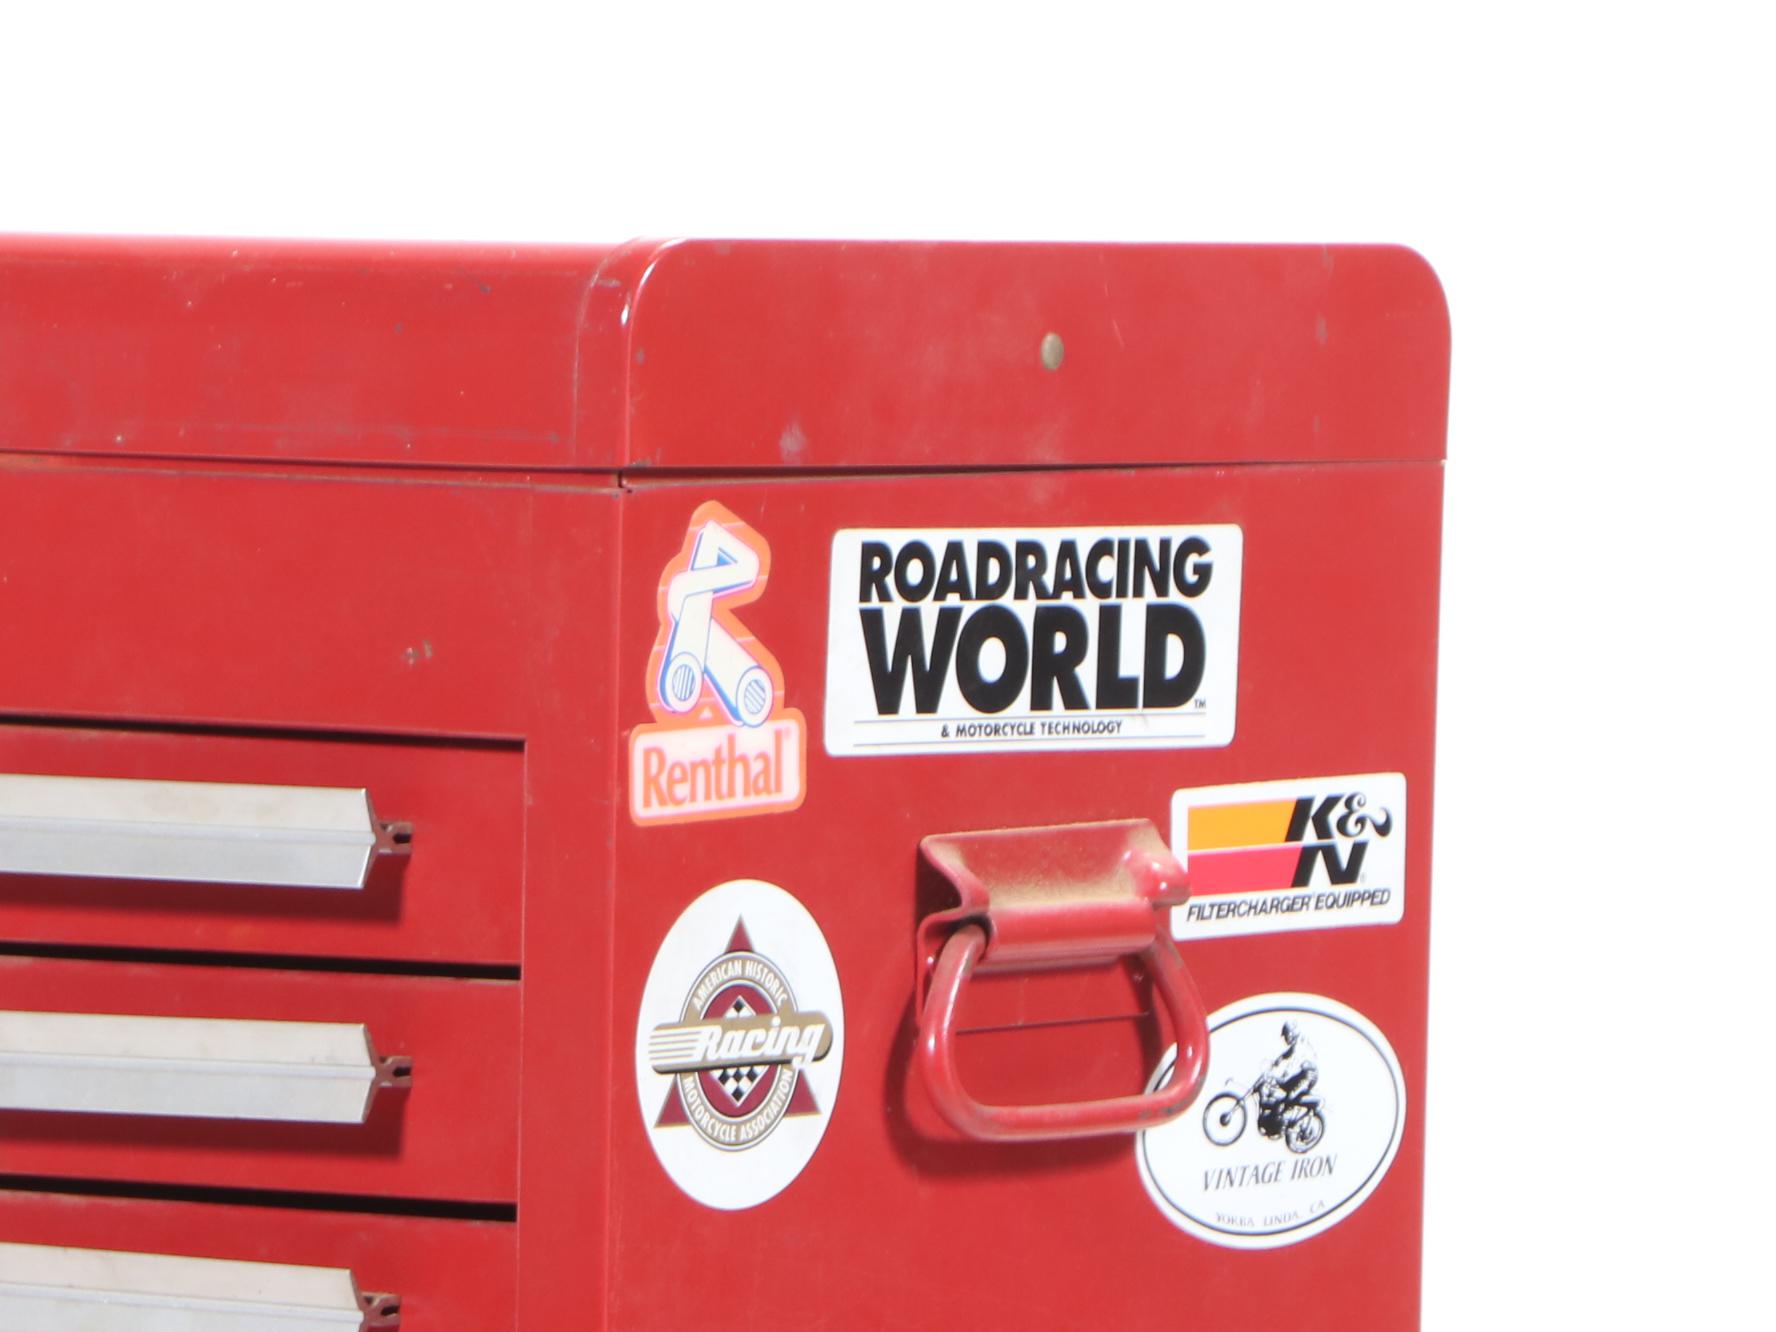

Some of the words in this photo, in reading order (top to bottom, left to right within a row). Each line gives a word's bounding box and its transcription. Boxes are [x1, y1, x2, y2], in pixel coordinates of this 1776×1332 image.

[858, 536, 1215, 604] ROADRACING
[859, 603, 1207, 716] WORLD
[941, 724, 950, 738] &
[955, 721, 1036, 738] MOTORCYCLE
[1040, 719, 1123, 735] TECHNOLOGY
[642, 729, 784, 809] Renthal
[1186, 895, 1311, 923] FILTERCHARGER
[1314, 887, 1392, 912] EQUIPPED
[693, 959, 743, 1011] AMERICAN
[745, 959, 788, 1007] HISTORIC
[697, 1014, 827, 1071] Racing
[683, 1075, 736, 1143] MOTORCYCLE
[739, 1068, 794, 1141] ASSOCIATION
[1203, 1161, 1286, 1192] VINTAGE
[1290, 1153, 1338, 1181] IRON
